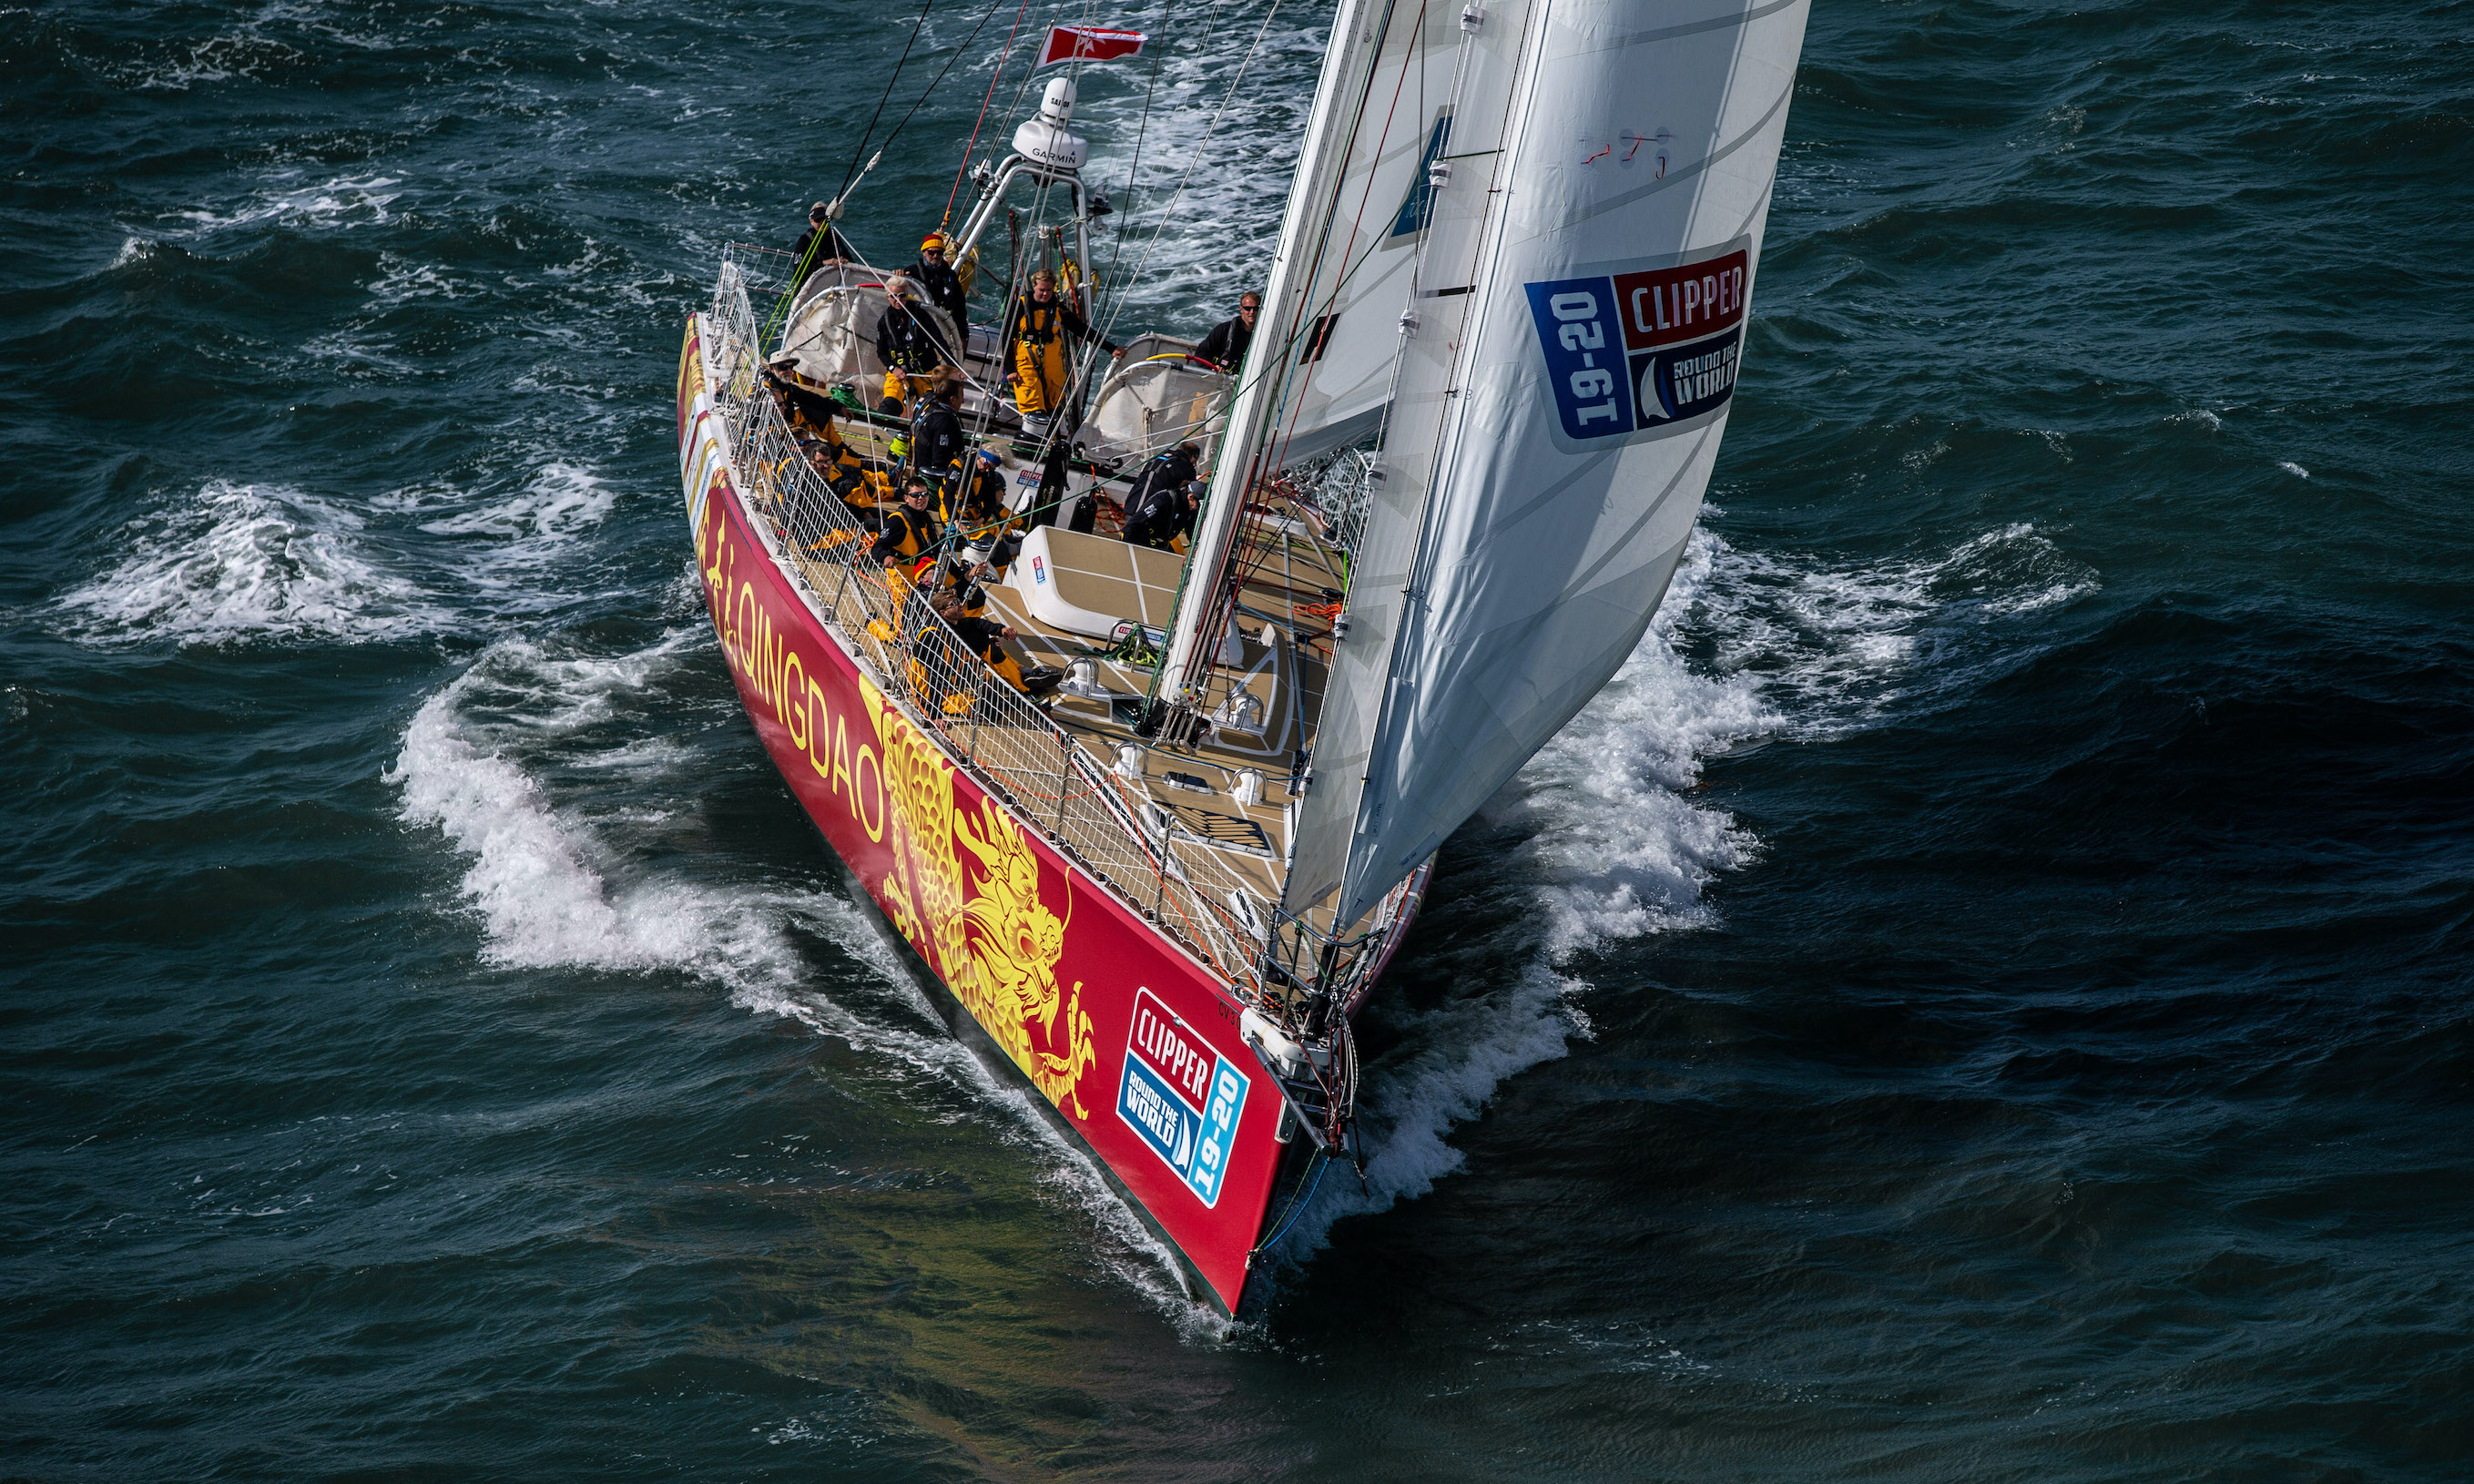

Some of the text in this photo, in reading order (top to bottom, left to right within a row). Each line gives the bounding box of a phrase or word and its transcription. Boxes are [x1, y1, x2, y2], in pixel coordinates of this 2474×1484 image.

[1050, 97, 1070, 108] SAIO
[1032, 147, 1076, 164] GARMIN
[1631, 266, 1743, 333] CLIPPER
[1550, 291, 1618, 426] 19-20
[1674, 341, 1737, 380] ROUND THE
[1675, 360, 1735, 405] WORLD
[738, 581, 884, 844] QINGDAO
[1137, 1008, 1208, 1101] CLIPPER
[1126, 1084, 1176, 1149] WORLD
[1128, 1070, 1179, 1128] ROUND THE
[1194, 1069, 1239, 1196] 19-20
